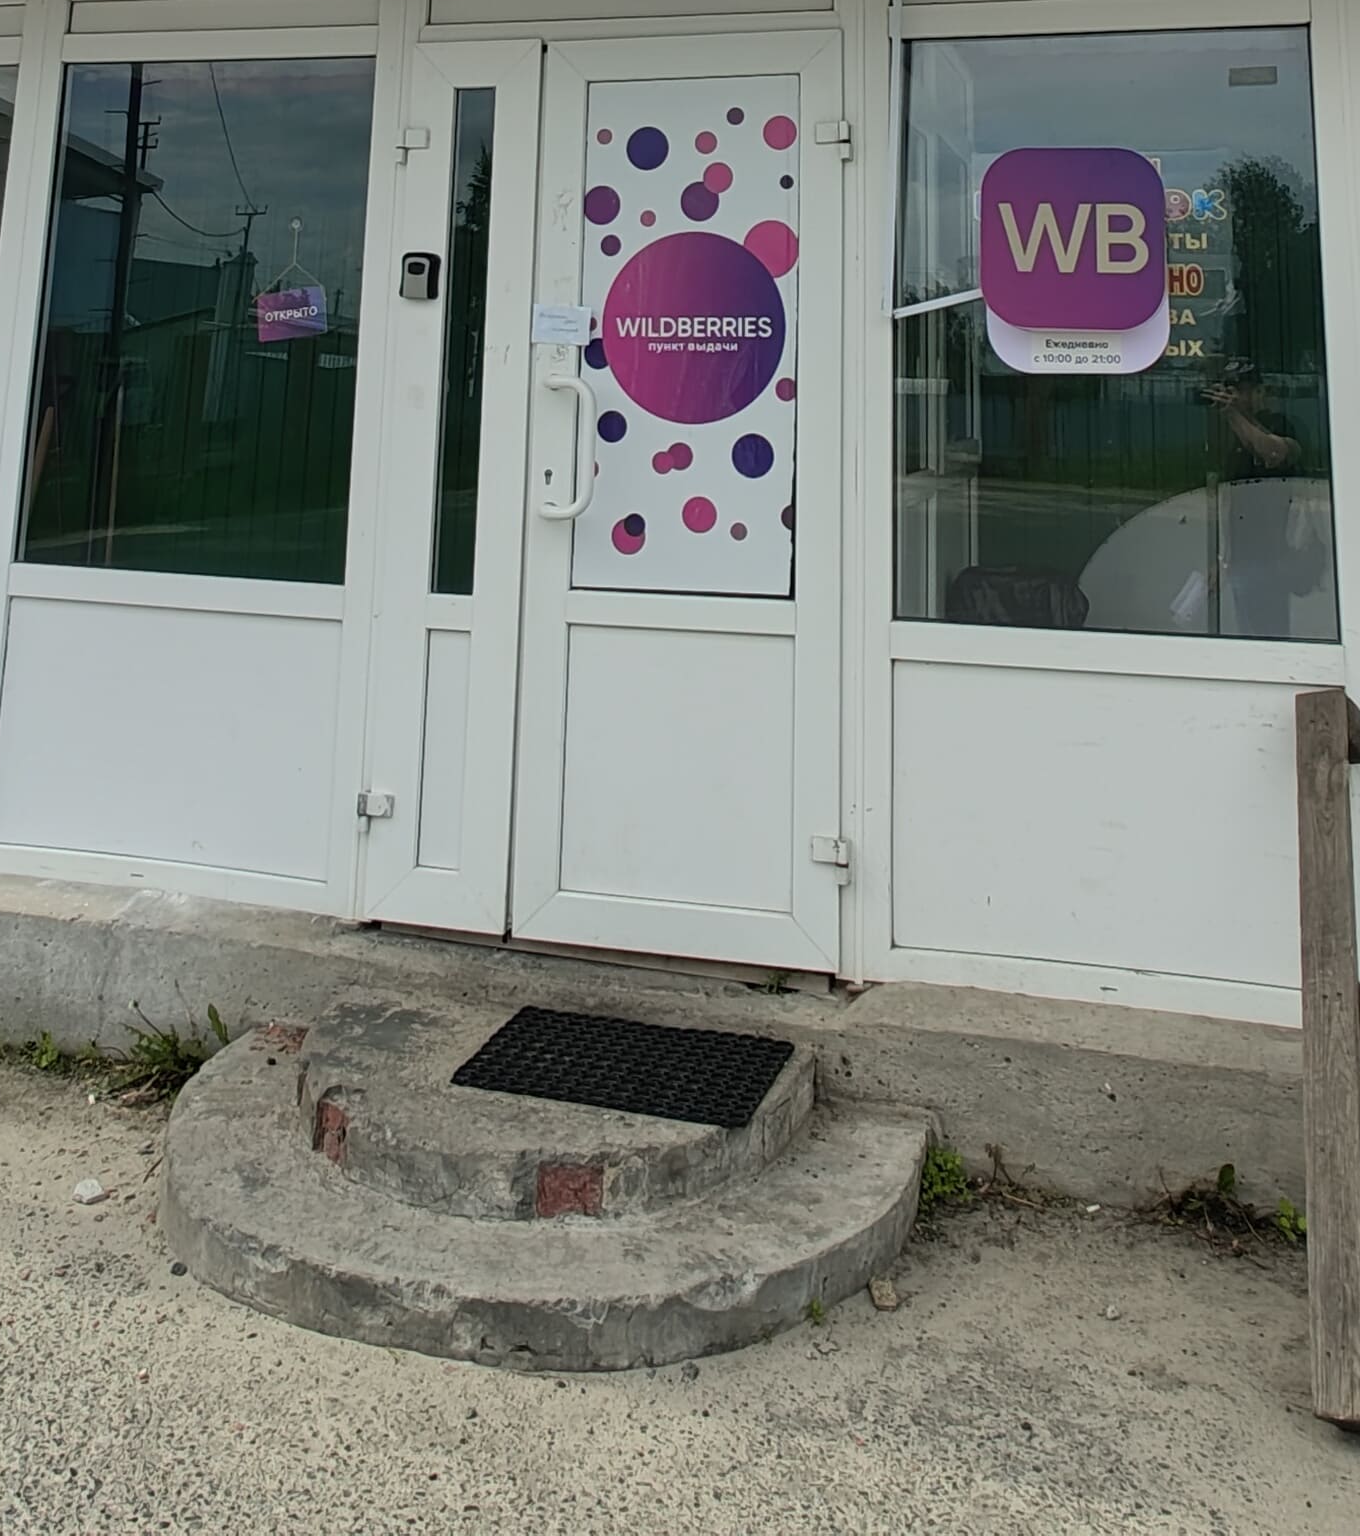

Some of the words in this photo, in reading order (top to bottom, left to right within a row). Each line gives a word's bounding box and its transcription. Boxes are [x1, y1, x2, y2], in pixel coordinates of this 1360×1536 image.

[997, 202, 1150, 274] WB
[264, 305, 318, 322] ОТКРЫТО
[615, 316, 773, 338] WILDBERRIES
[648, 342, 685, 353] пункт
[688, 342, 738, 352] выдачи
[1045, 339, 1109, 349] Ежедневно
[1043, 354, 1072, 363] 10:00
[1074, 355, 1089, 364] до
[1091, 354, 1121, 364] 21:00
